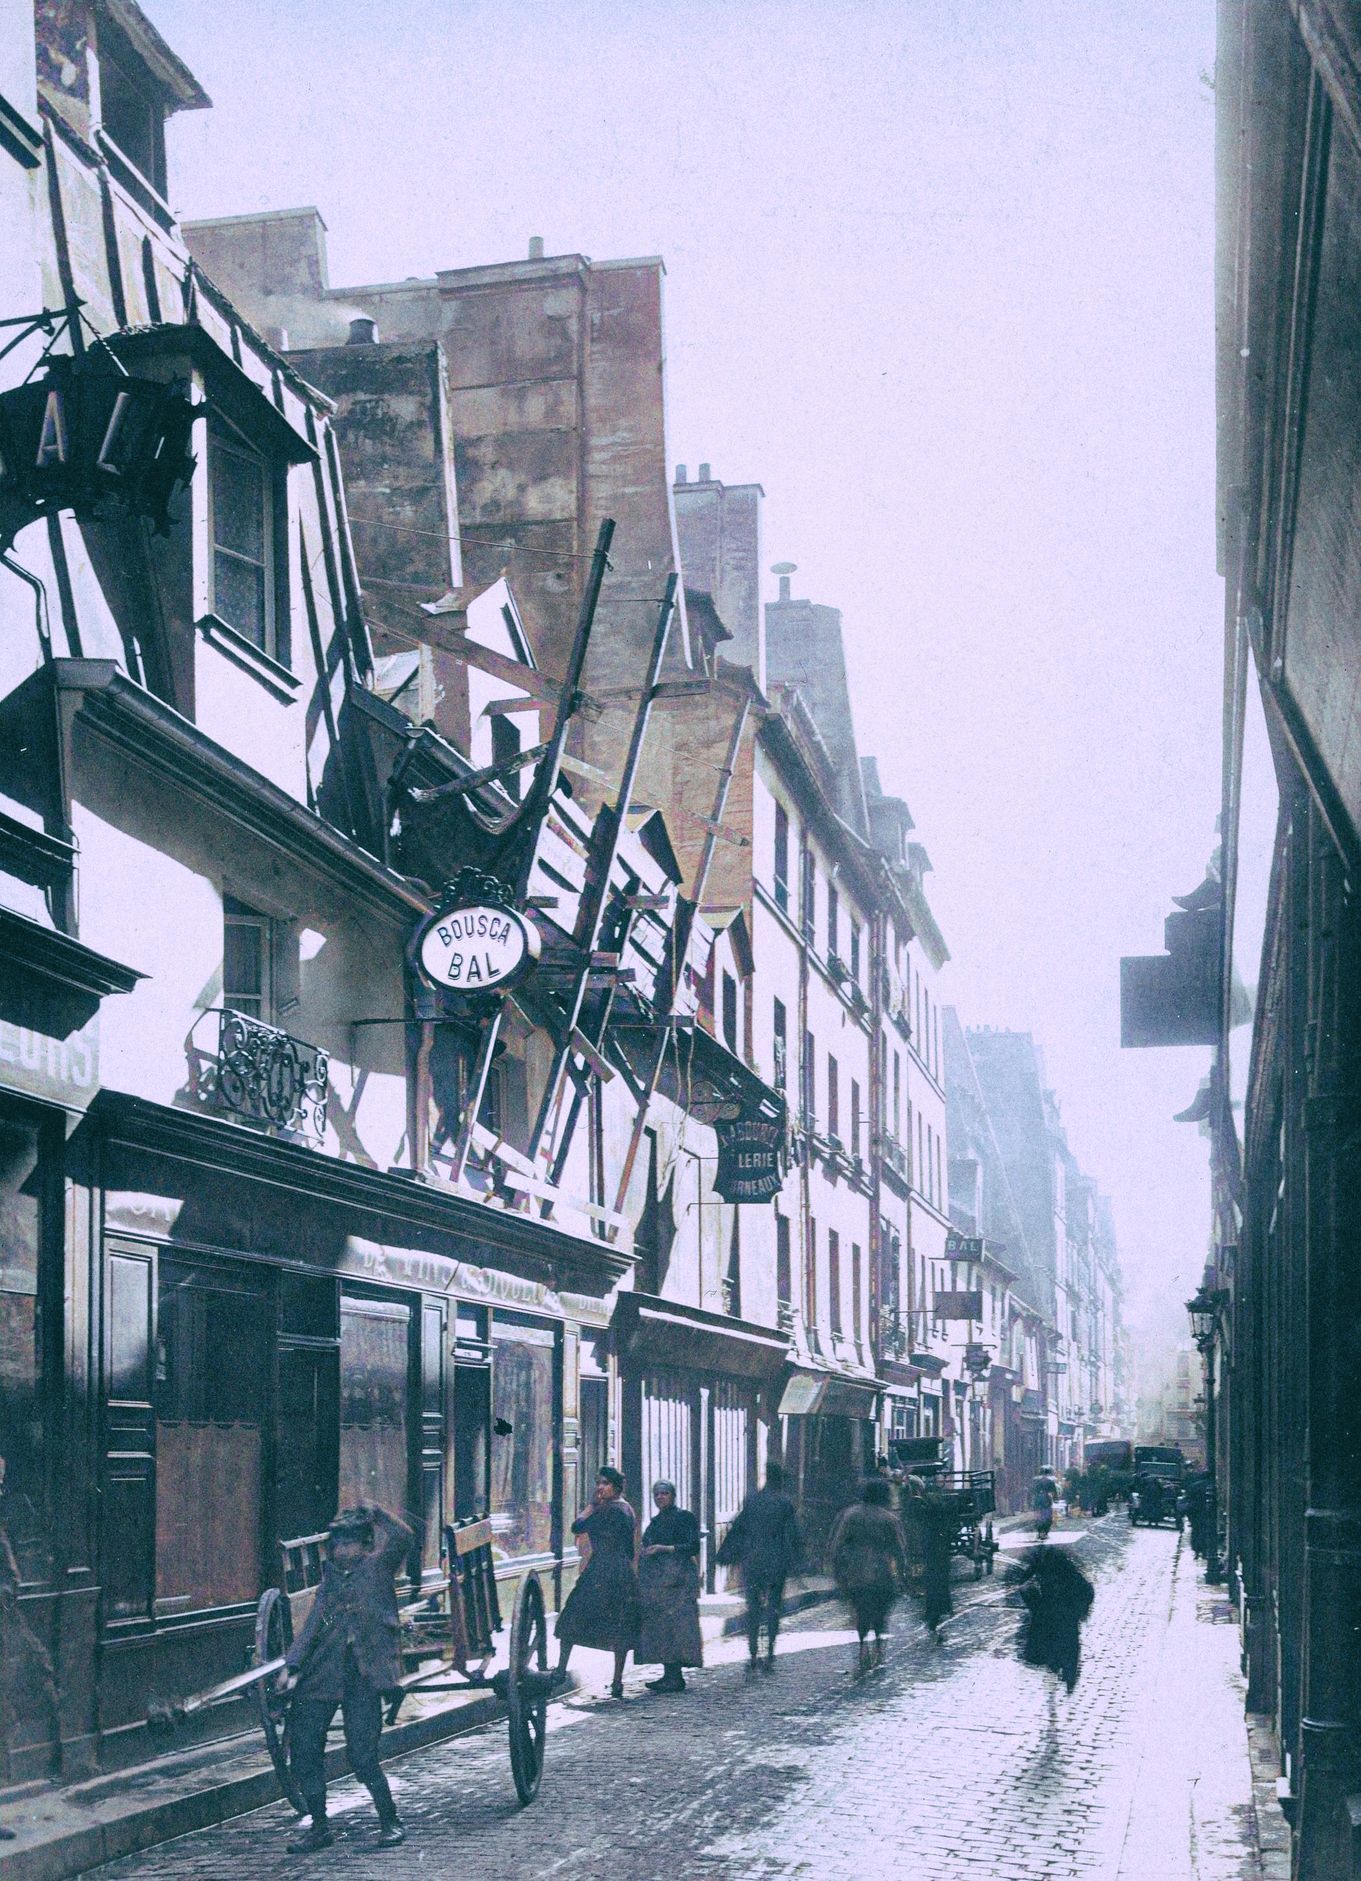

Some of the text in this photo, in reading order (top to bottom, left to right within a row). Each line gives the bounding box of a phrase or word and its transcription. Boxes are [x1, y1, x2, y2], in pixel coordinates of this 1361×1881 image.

[437, 914, 512, 947] BOUSCA
[447, 952, 501, 982] BAL
[947, 1240, 978, 1251] BAL
